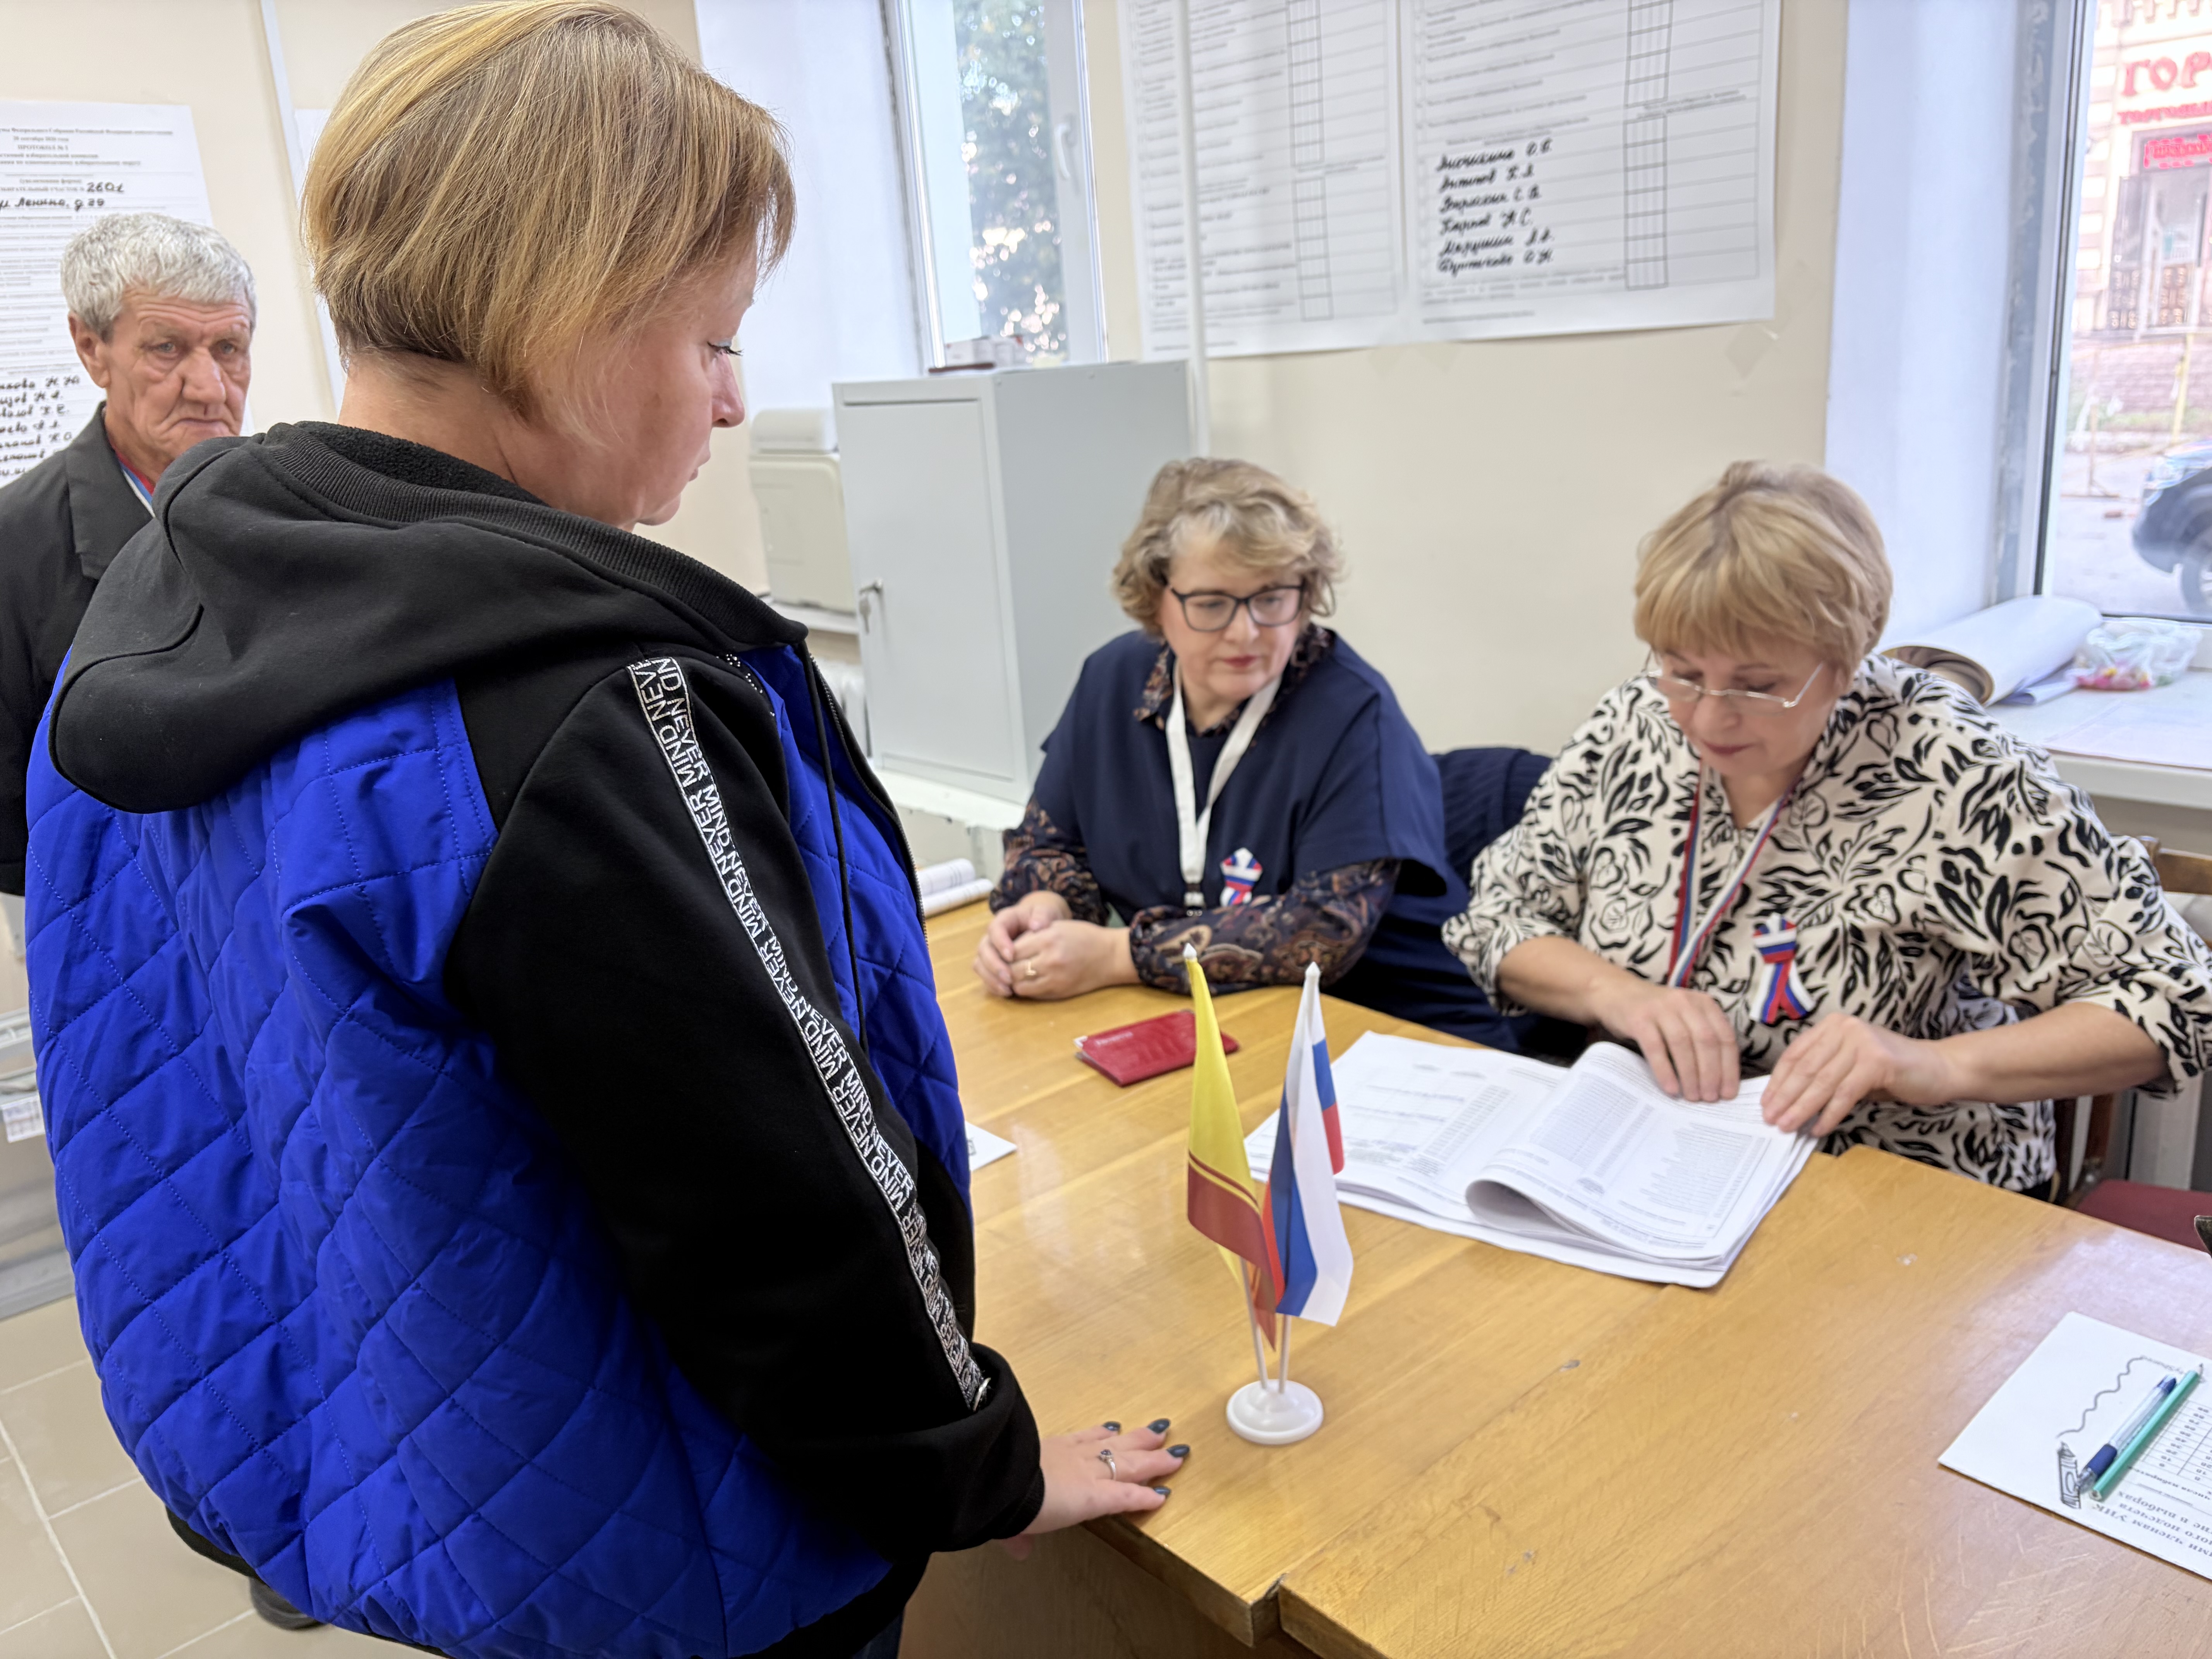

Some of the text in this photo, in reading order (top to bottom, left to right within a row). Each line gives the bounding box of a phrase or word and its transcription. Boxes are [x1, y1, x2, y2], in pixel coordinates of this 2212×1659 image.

[2121, 51, 2212, 97] ГОР
[632, 660, 671, 721] NEVE
[658, 723, 697, 788] MIND
[689, 789, 732, 876] NEVER
[651, 658, 914, 1198] ND NEVER MIND NEVER MIND NEVER MIND NEVER
[726, 878, 762, 938] MIND
[759, 941, 805, 1020] NEVER
[804, 1020, 839, 1080] MIND
[832, 1079, 874, 1158] NEVER
[871, 1155, 907, 1211] MIND
[2119, 1491, 2177, 1519] выборах
[2128, 1465, 2179, 1488] избирате
[2119, 1503, 2180, 1532] подсчета
[2131, 1519, 2183, 1545] членам
